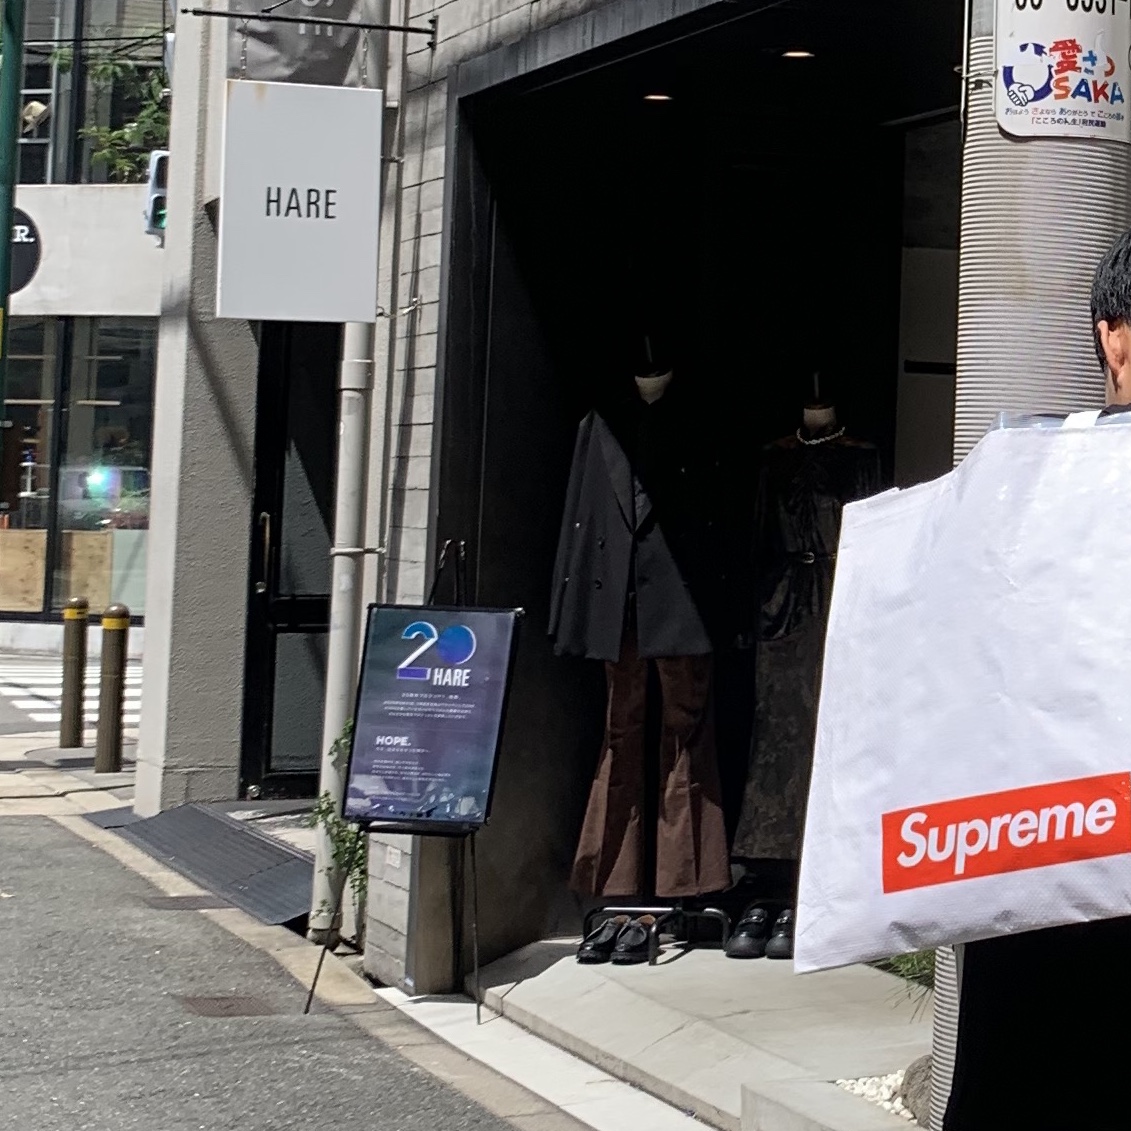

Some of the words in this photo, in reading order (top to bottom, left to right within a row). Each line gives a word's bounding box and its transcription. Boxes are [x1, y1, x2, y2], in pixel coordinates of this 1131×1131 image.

[266, 186, 337, 219] HARE
[396, 621, 477, 680] 20
[433, 668, 471, 687] HARE
[375, 736, 412, 747] HOPE.
[897, 798, 1117, 875] Supreme
